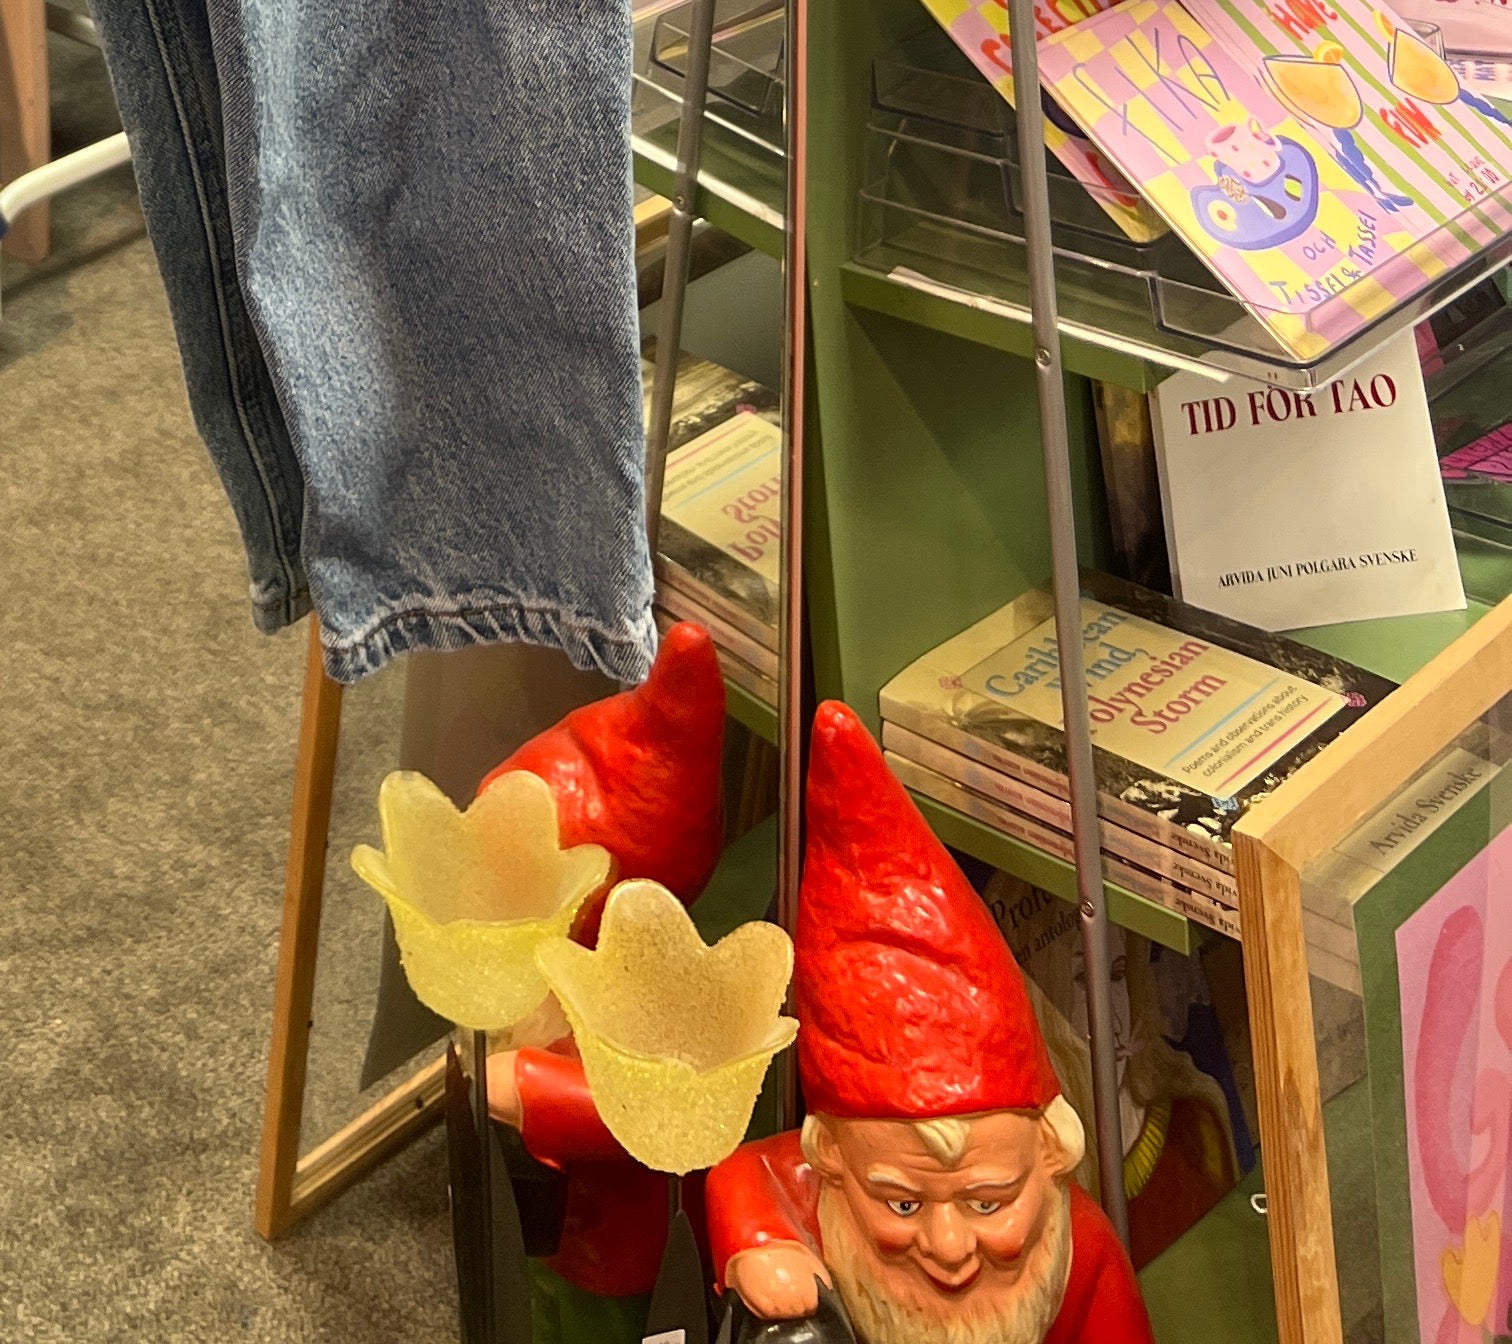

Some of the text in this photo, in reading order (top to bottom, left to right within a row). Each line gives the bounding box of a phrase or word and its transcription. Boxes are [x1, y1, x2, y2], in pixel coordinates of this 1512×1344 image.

[1181, 395, 1236, 435] TID
[1330, 373, 1397, 413] TAO
[1218, 569, 1264, 589] ARVIDA
[1359, 548, 1418, 569] SVENSKE
[1078, 637, 1210, 735] olynesian
[1130, 671, 1228, 736] Storm
[1182, 685, 1298, 774] Poems and observations about
[1202, 741, 1247, 777] colonialism
[1368, 766, 1482, 856] Arvida Svenske
